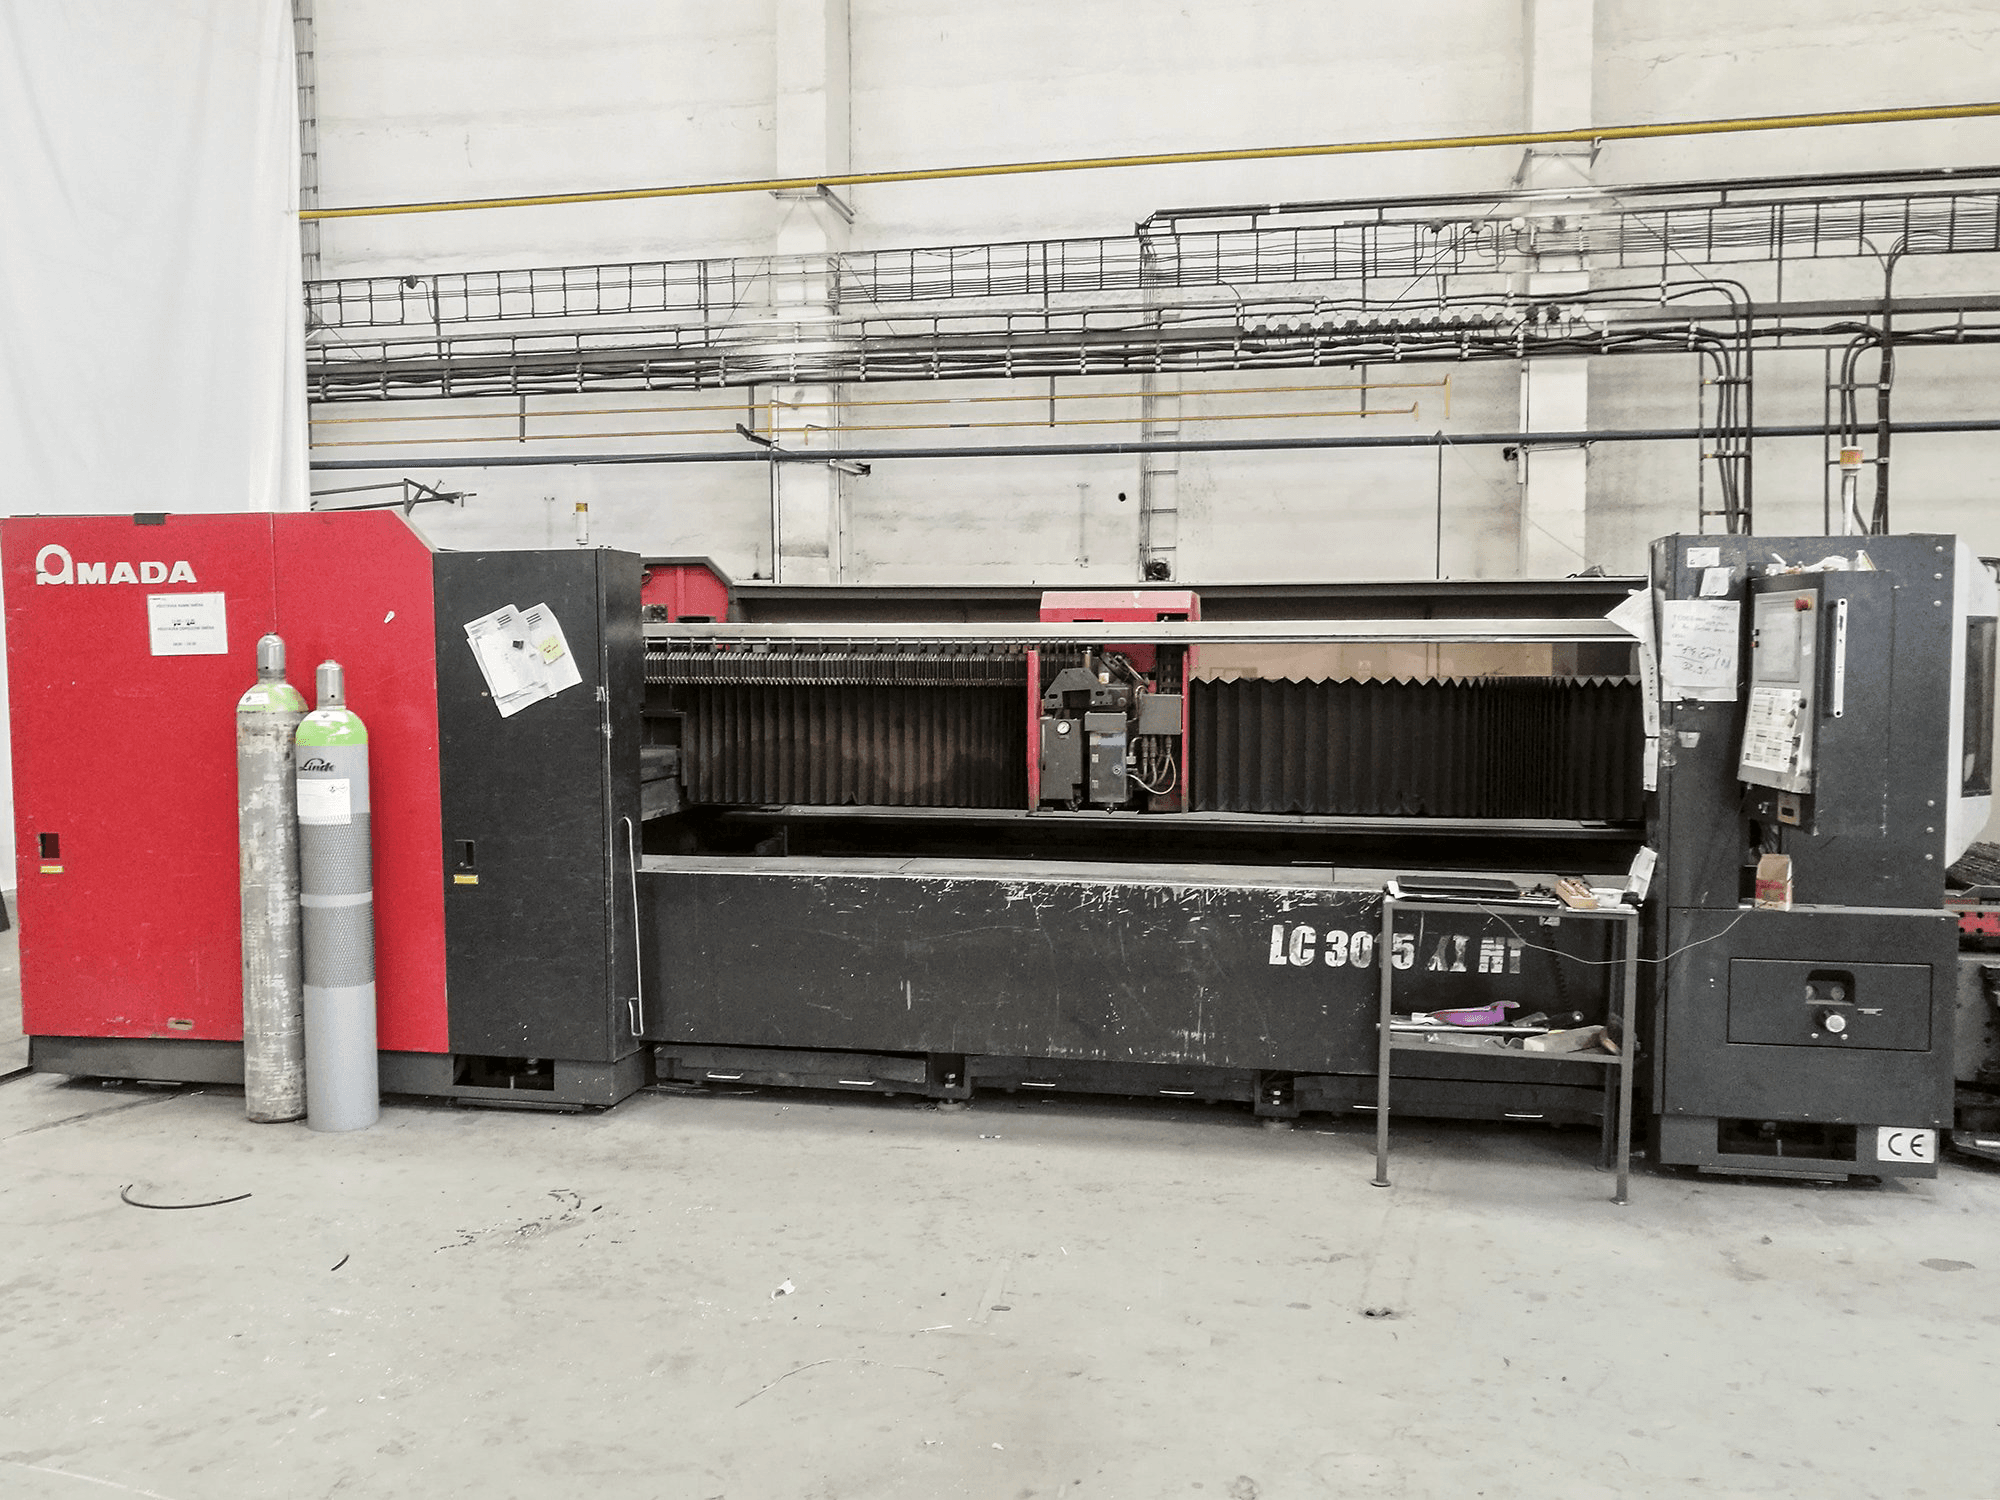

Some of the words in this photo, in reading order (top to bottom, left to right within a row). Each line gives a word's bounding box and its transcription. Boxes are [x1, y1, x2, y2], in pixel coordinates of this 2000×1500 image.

[36, 544, 198, 585] AMADA
[299, 757, 334, 772] Linde
[1269, 924, 1317, 967] LC
[1887, 1132, 1925, 1158] CE
